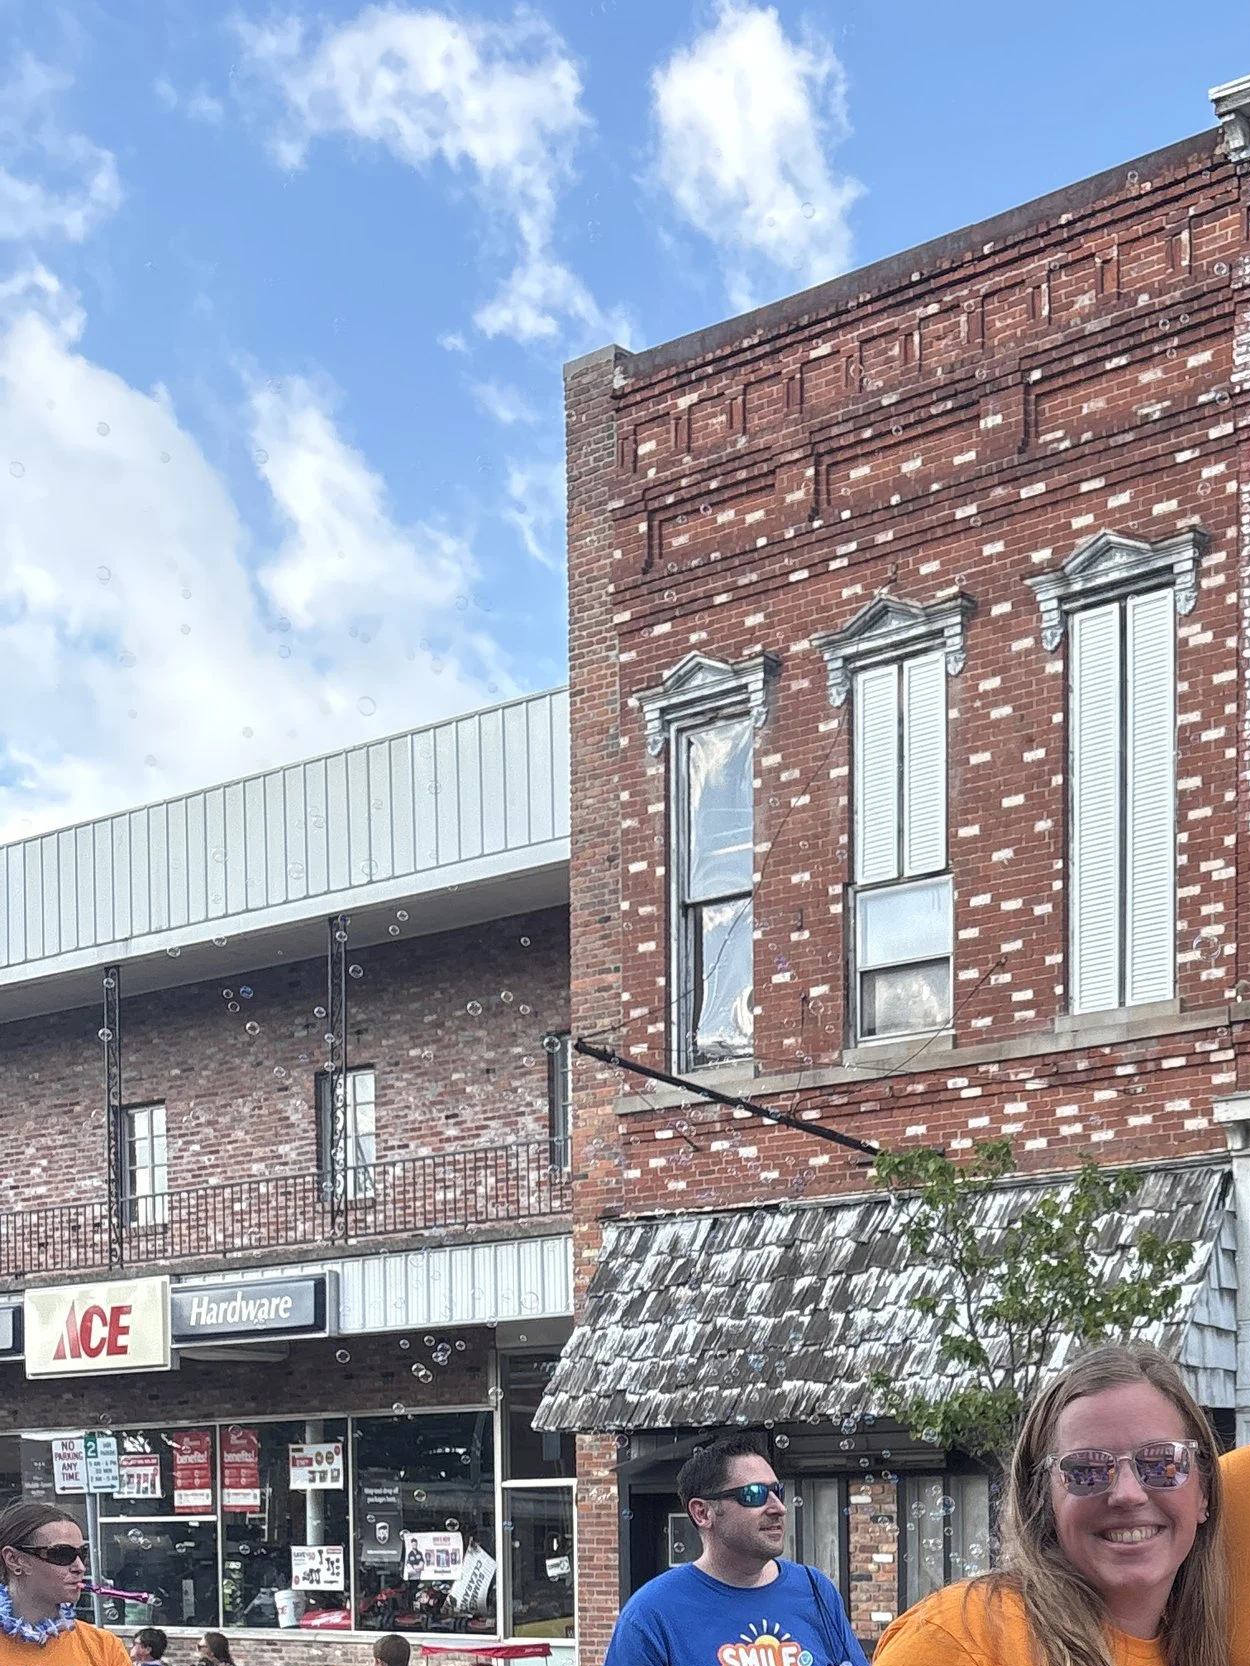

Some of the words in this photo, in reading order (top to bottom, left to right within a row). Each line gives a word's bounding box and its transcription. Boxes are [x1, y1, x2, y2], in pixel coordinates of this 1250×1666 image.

[190, 1291, 292, 1327] Hardware
[53, 1300, 132, 1360] ACE
[61, 1441, 75, 1451] NO
[87, 1441, 97, 1457] 2
[54, 1451, 83, 1461] PARKING
[62, 1462, 77, 1471] ANY
[62, 1472, 80, 1481] TIME
